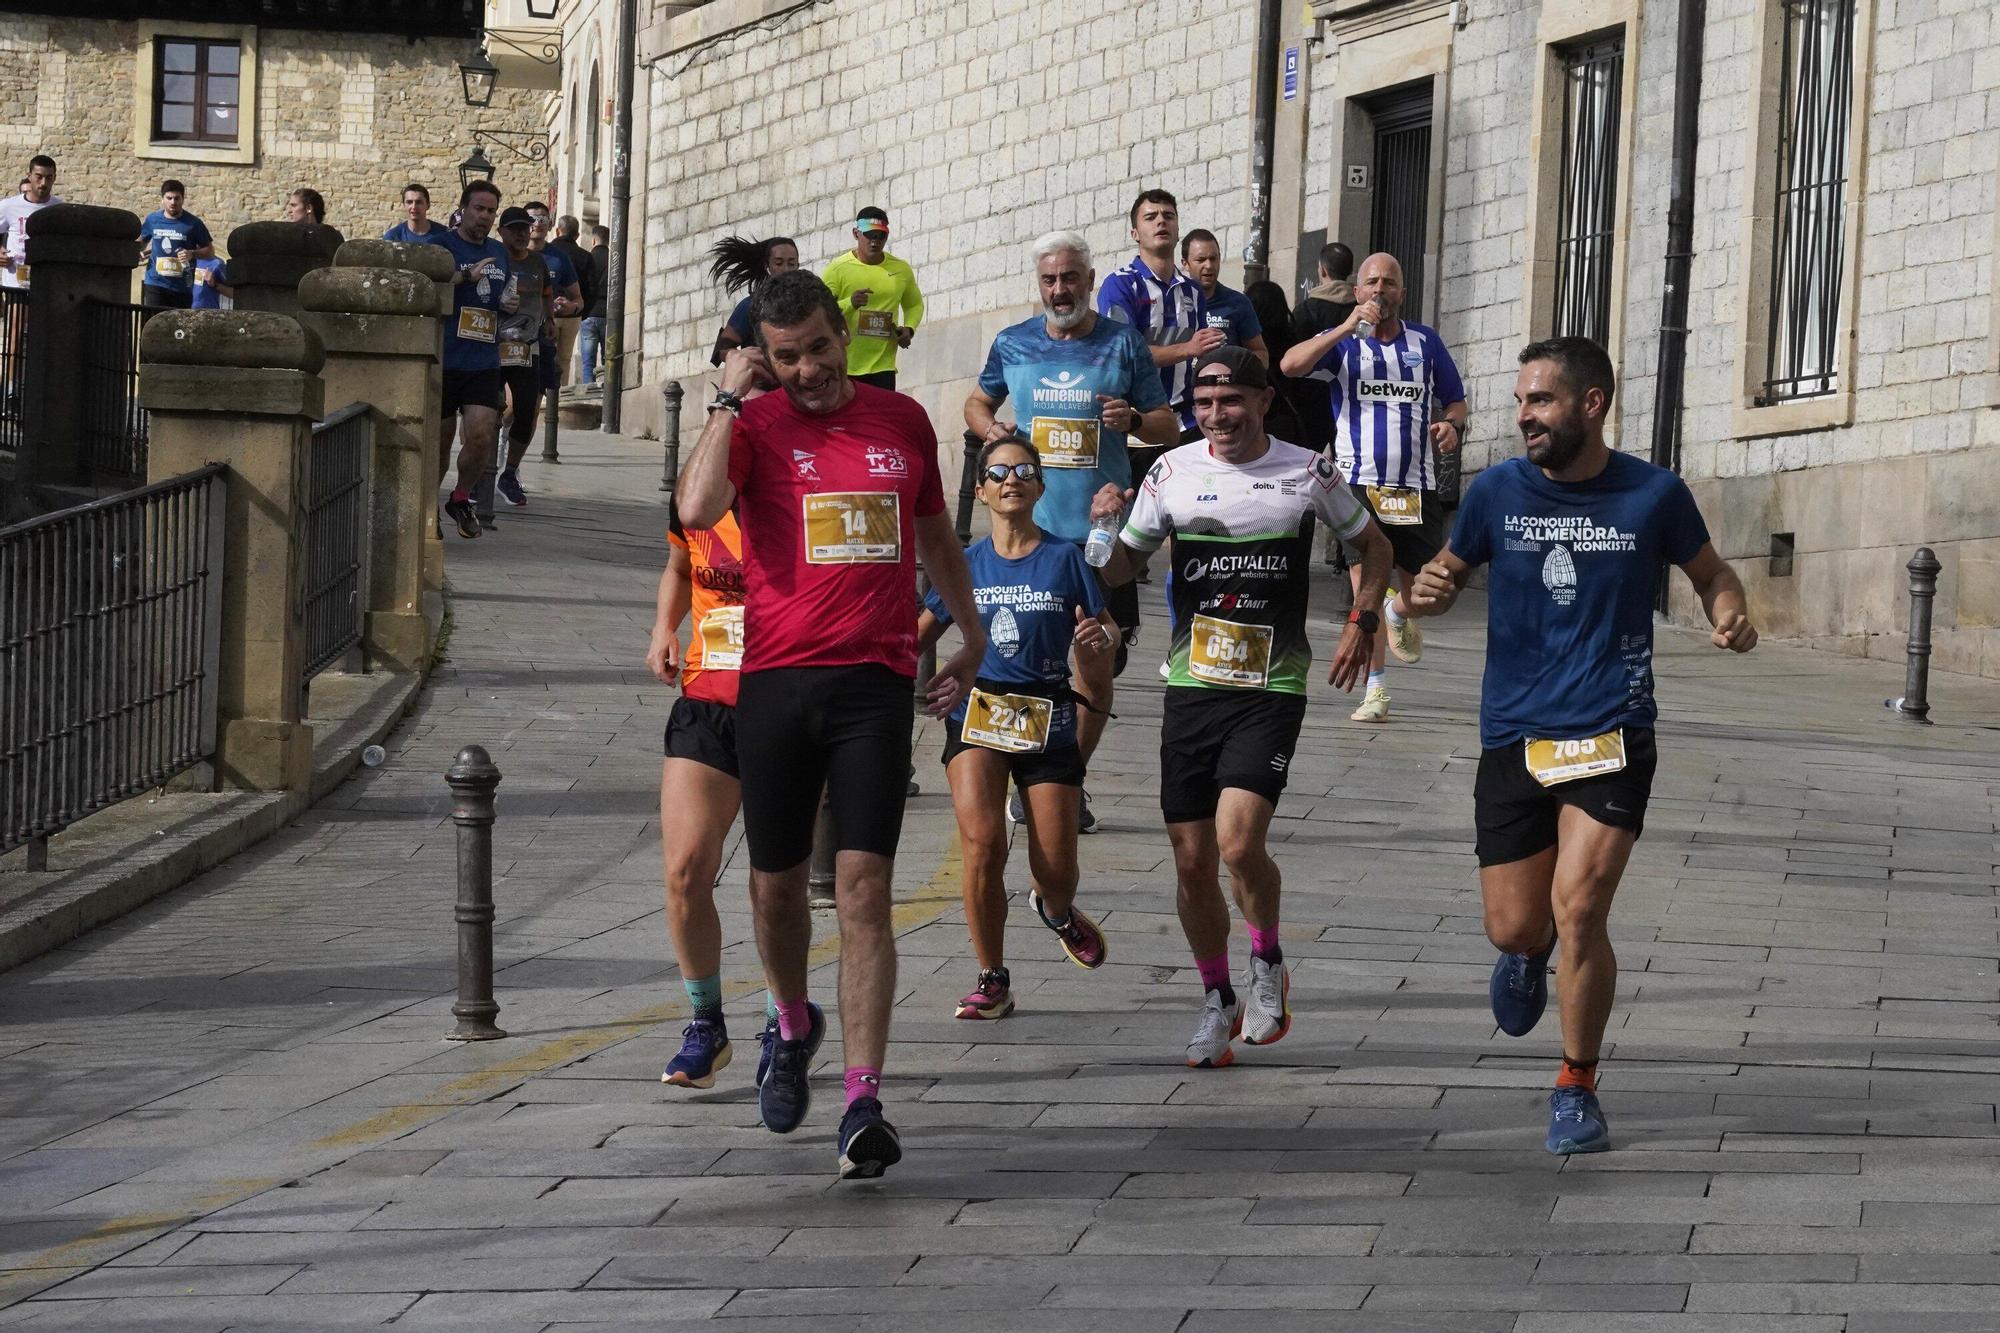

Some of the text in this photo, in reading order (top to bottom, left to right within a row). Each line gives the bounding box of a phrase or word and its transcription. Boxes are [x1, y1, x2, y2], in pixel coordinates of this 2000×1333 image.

[1360, 381, 1423, 401] betway
[1033, 402, 1091, 410] RIOJA ALAVESA
[1048, 430, 1082, 450] 699
[1317, 458, 1334, 479] C
[1253, 482, 1275, 490] doitu
[881, 499, 893, 507] 10K
[1380, 496, 1407, 510] 200
[841, 510, 868, 536] 14
[1504, 515, 1592, 529] LA CONQUISTA
[1522, 527, 1619, 541] ALMENDRA
[1620, 533, 1636, 541] REN
[1573, 541, 1636, 552] KONKISTA
[1210, 555, 1288, 571] ACTUALIZA
[1240, 570, 1269, 579] websites
[973, 585, 1032, 596] CONQUISTA
[975, 591, 1053, 605] ALMENDRA
[1235, 599, 1269, 609] LIMIT
[1015, 602, 1064, 613] KONKISTA
[1206, 634, 1249, 663] 654
